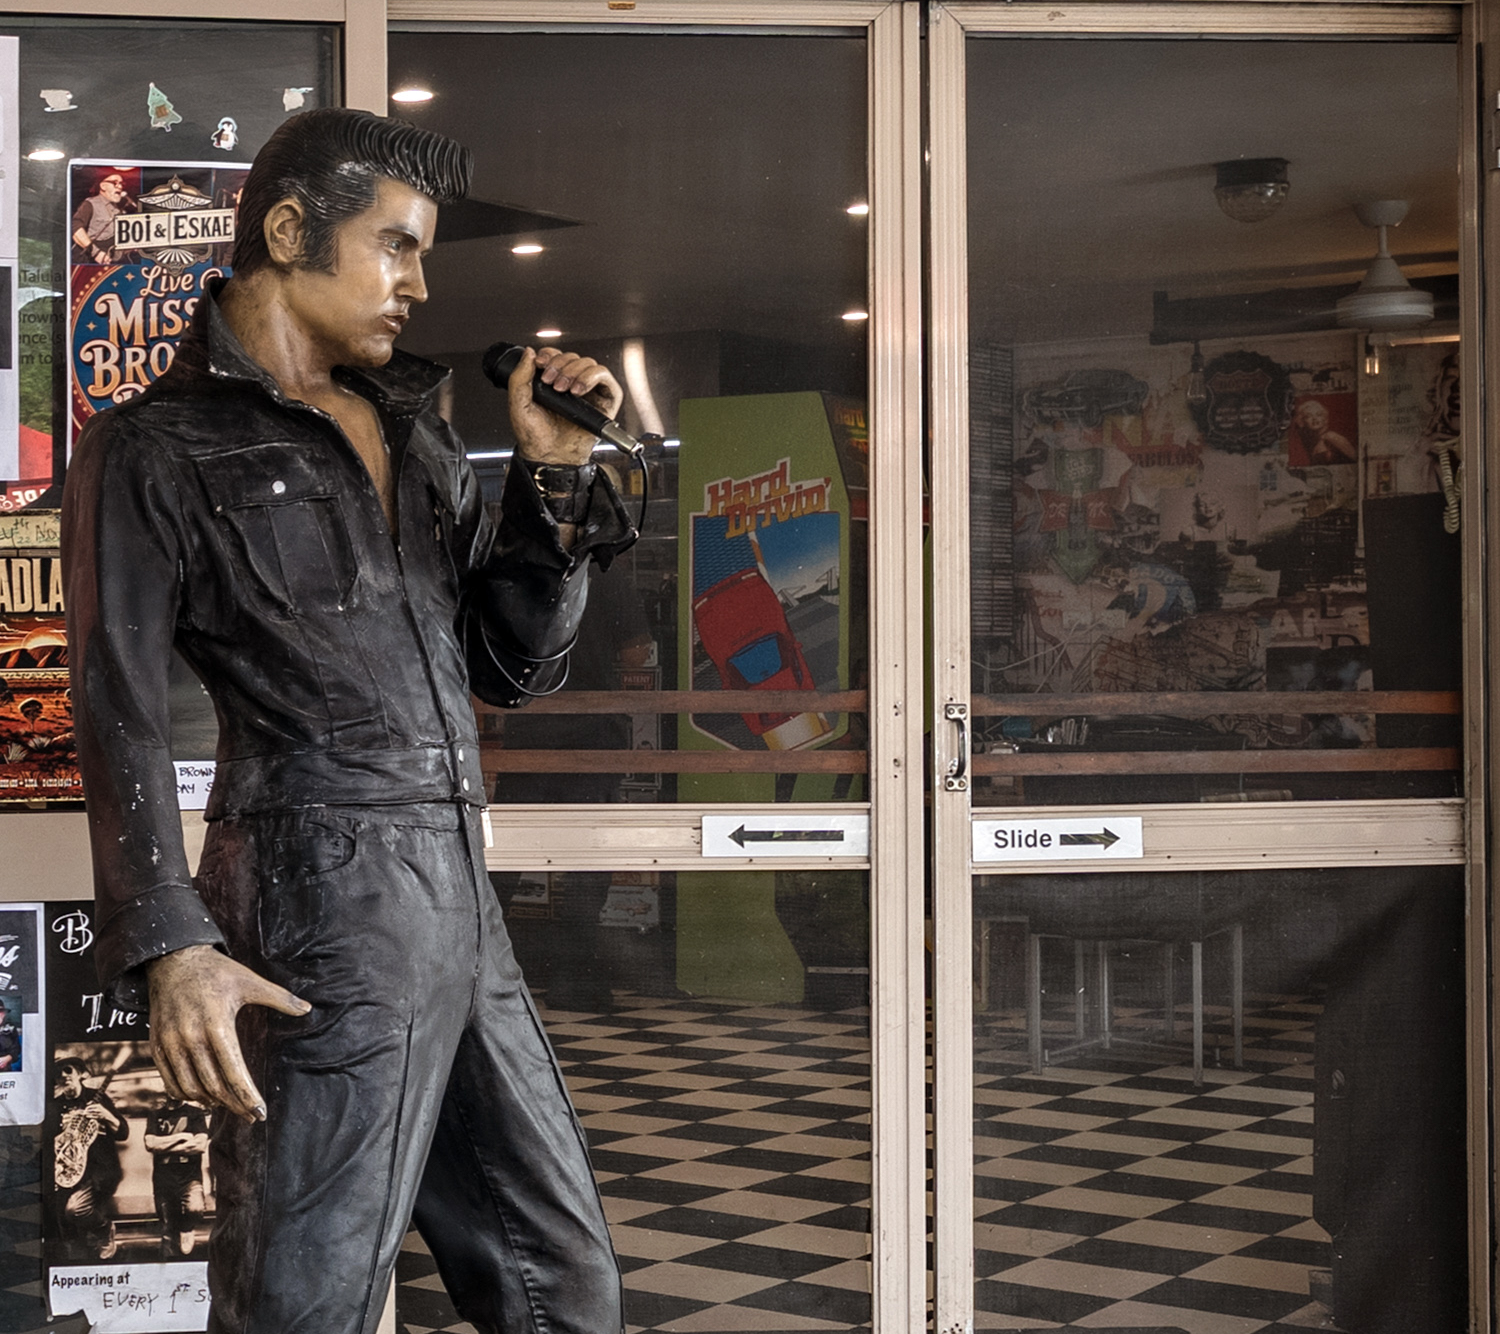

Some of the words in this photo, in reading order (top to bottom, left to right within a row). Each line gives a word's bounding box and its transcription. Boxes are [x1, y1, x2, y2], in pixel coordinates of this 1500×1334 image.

[154, 223, 167, 240] &
[140, 267, 195, 297] Live
[79, 339, 182, 401] BRO
[707, 460, 792, 518] Hard
[993, 828, 1053, 850] Slide
[51, 1273, 114, 1287] Appearing
[116, 1272, 131, 1285] at
[102, 1291, 160, 1317] EVERY
